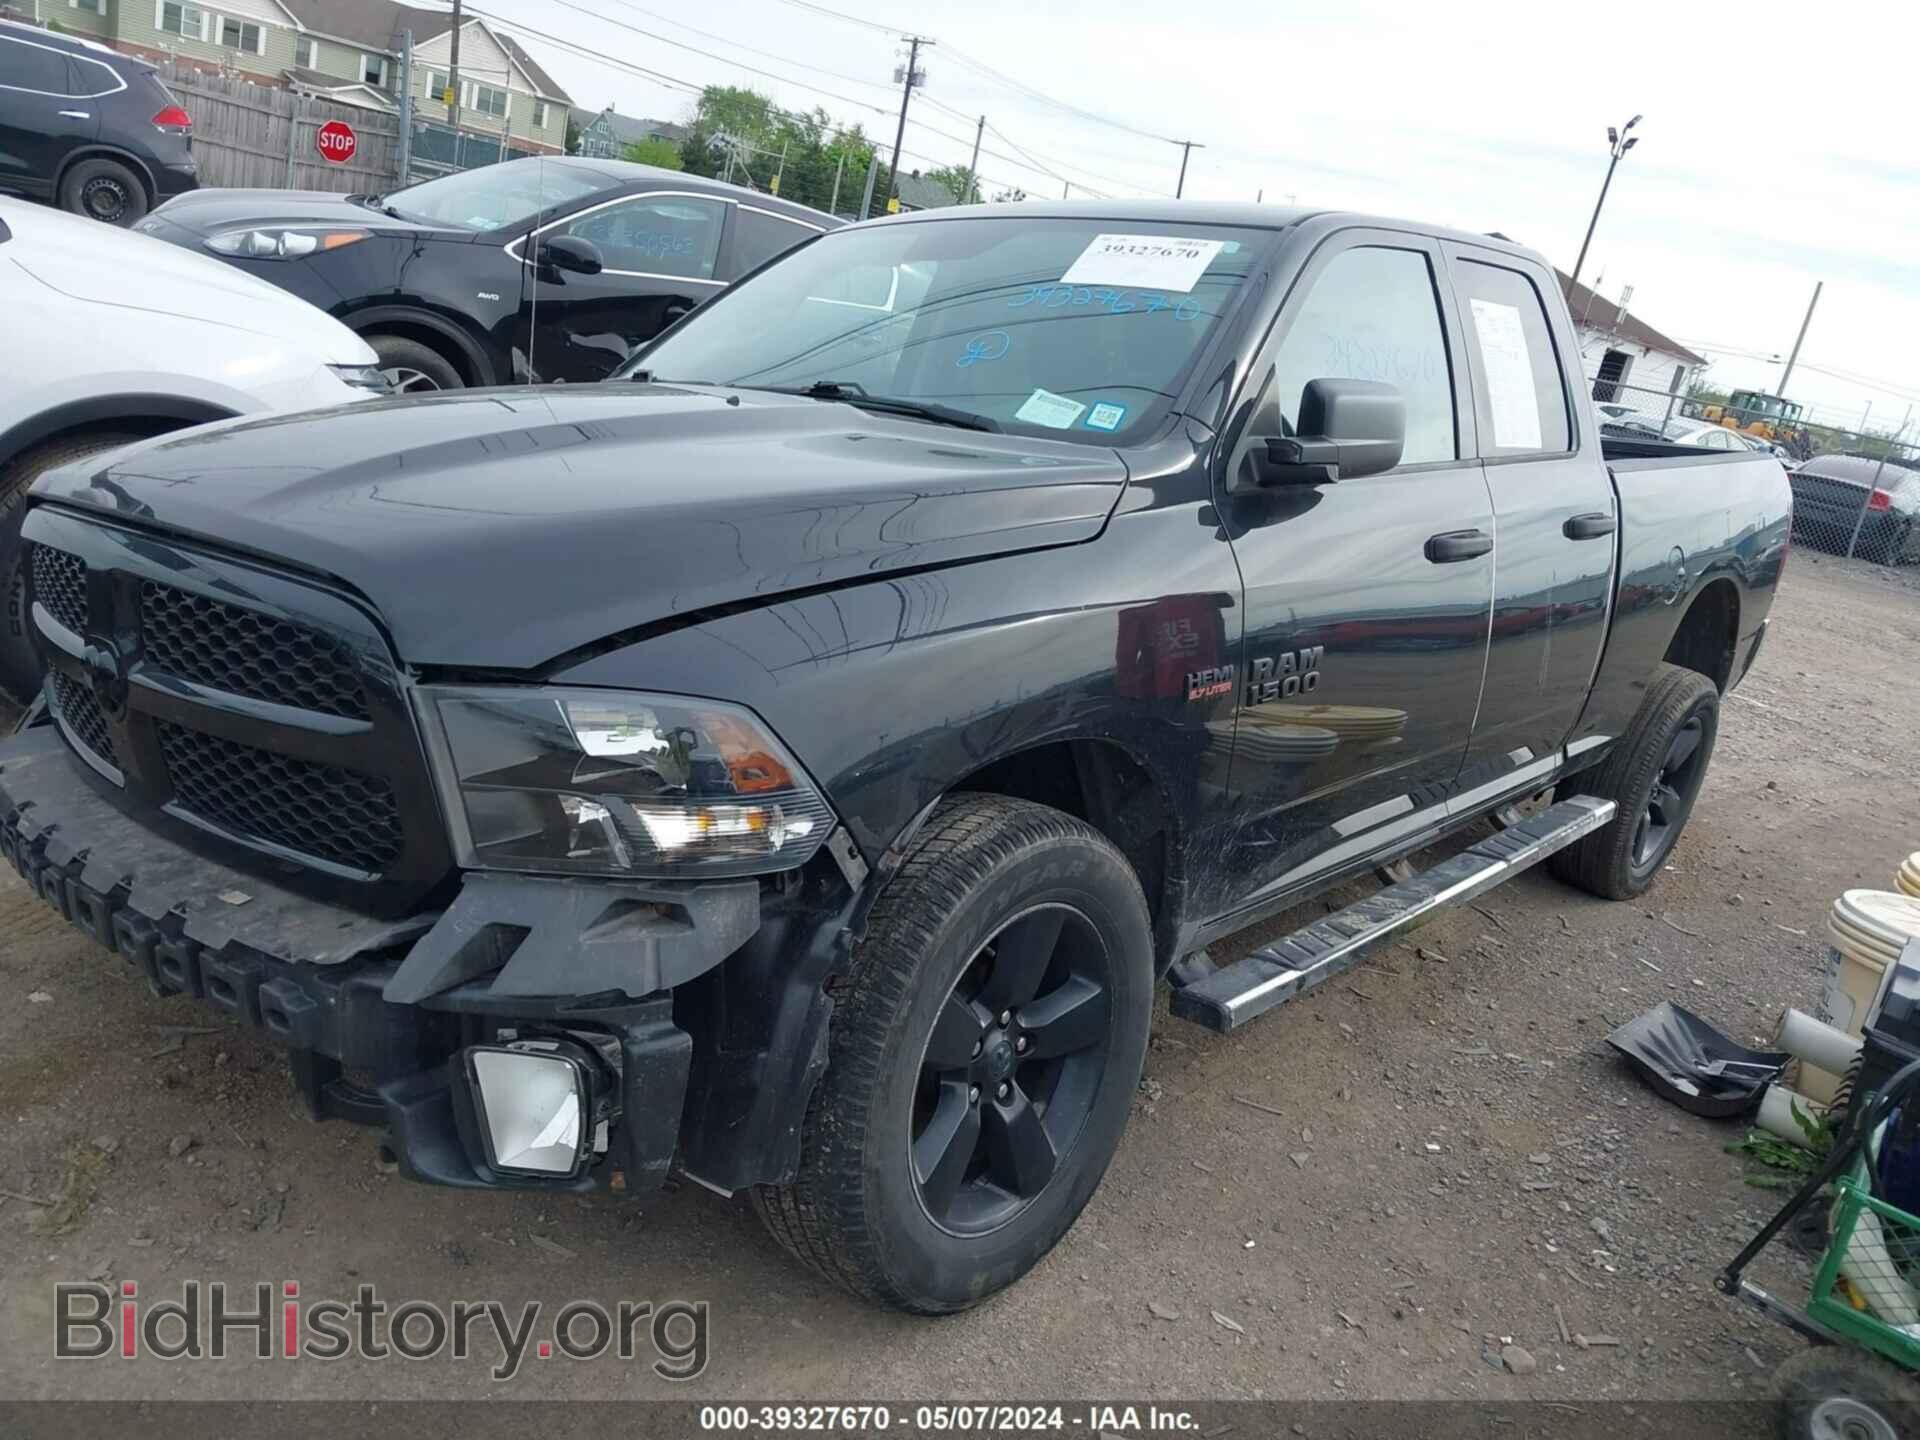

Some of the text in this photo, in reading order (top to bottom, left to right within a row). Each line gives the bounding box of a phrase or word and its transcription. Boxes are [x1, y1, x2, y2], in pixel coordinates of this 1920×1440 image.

[320, 131, 354, 152] STOP
[1099, 243, 1200, 260] 39327670
[1008, 285, 1202, 321] 39327670
[1187, 664, 1234, 688] HEMI
[1252, 645, 1325, 681] RAM
[1248, 671, 1321, 707] 1500
